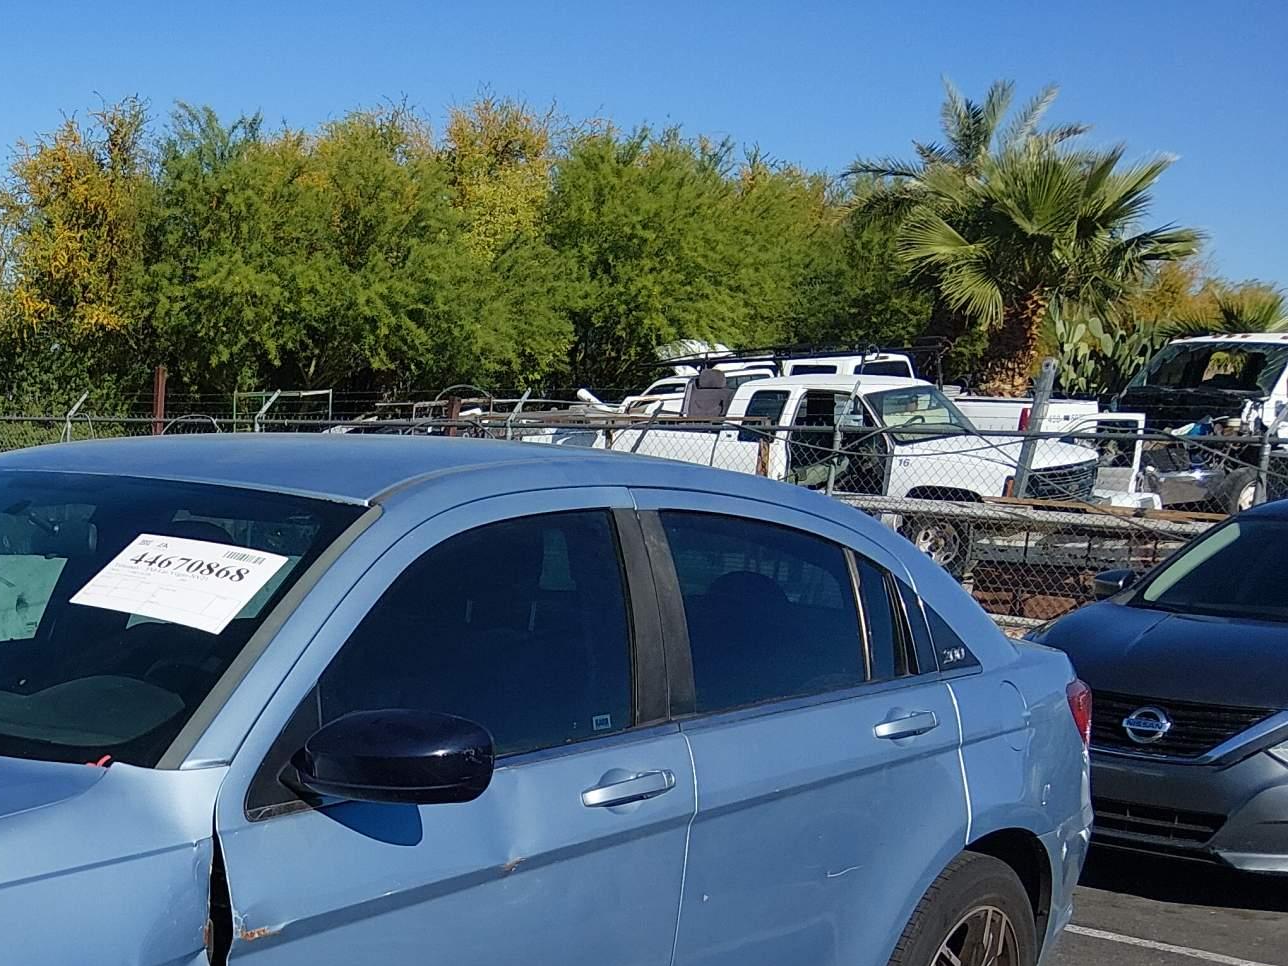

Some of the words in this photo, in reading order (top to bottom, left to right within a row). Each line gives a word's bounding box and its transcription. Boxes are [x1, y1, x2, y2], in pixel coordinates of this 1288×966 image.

[898, 458, 910, 467] 16
[130, 552, 250, 582] 44670868
[943, 647, 965, 664] 200
[1127, 718, 1163, 730] NISSAN
